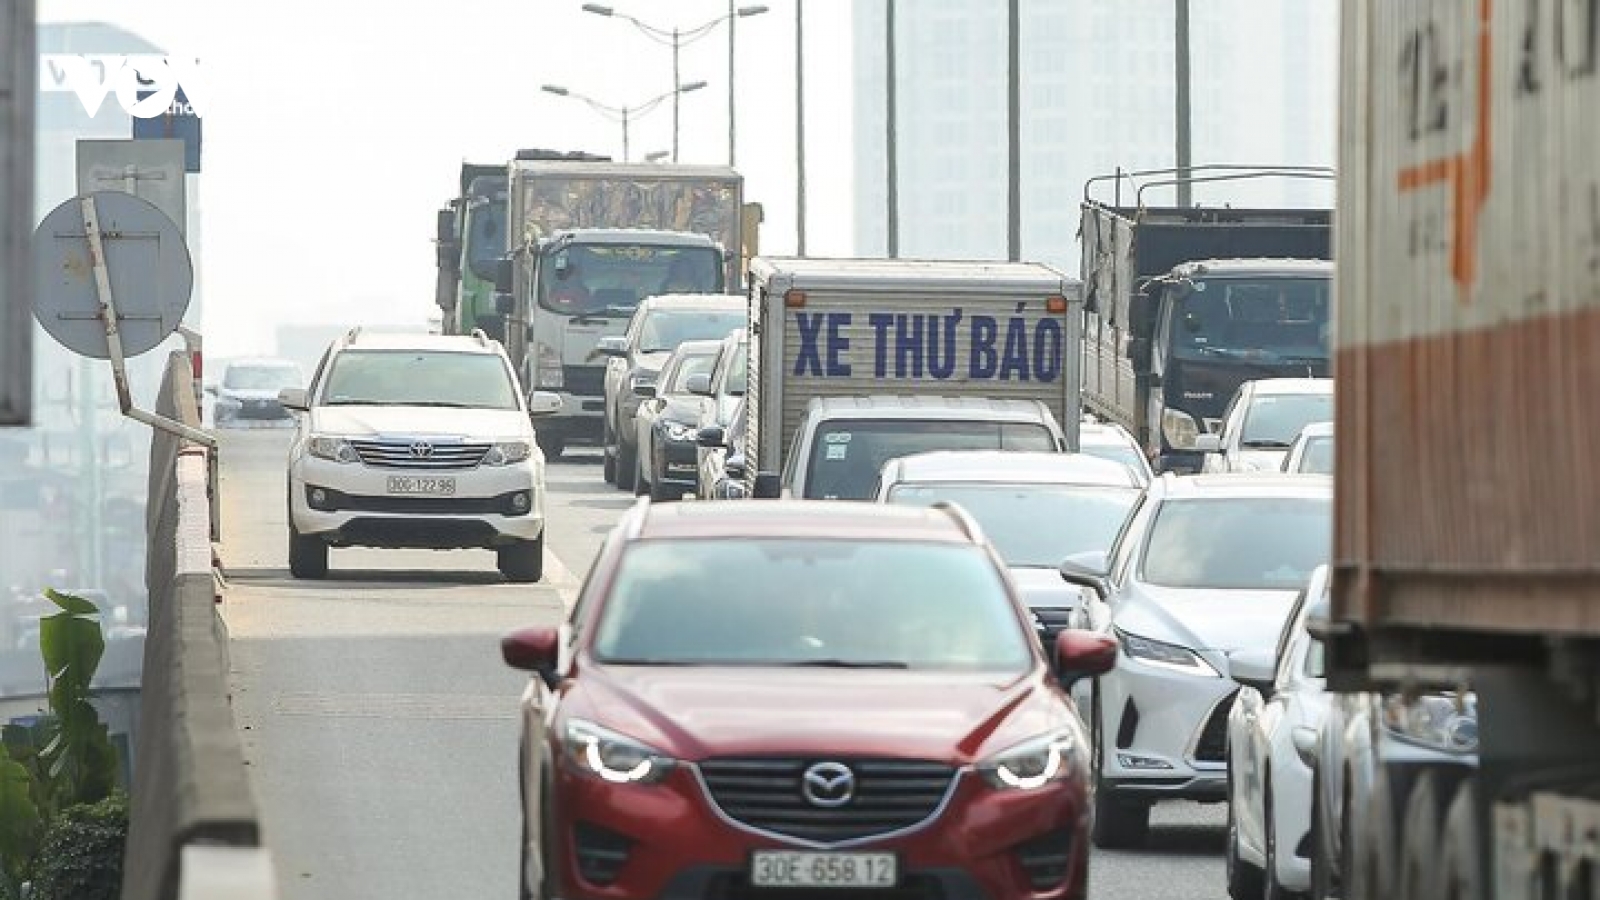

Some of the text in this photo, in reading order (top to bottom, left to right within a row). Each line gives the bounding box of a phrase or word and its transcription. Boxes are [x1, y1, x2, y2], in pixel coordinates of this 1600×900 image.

[793, 302, 1062, 384] XE THƯ BÁO
